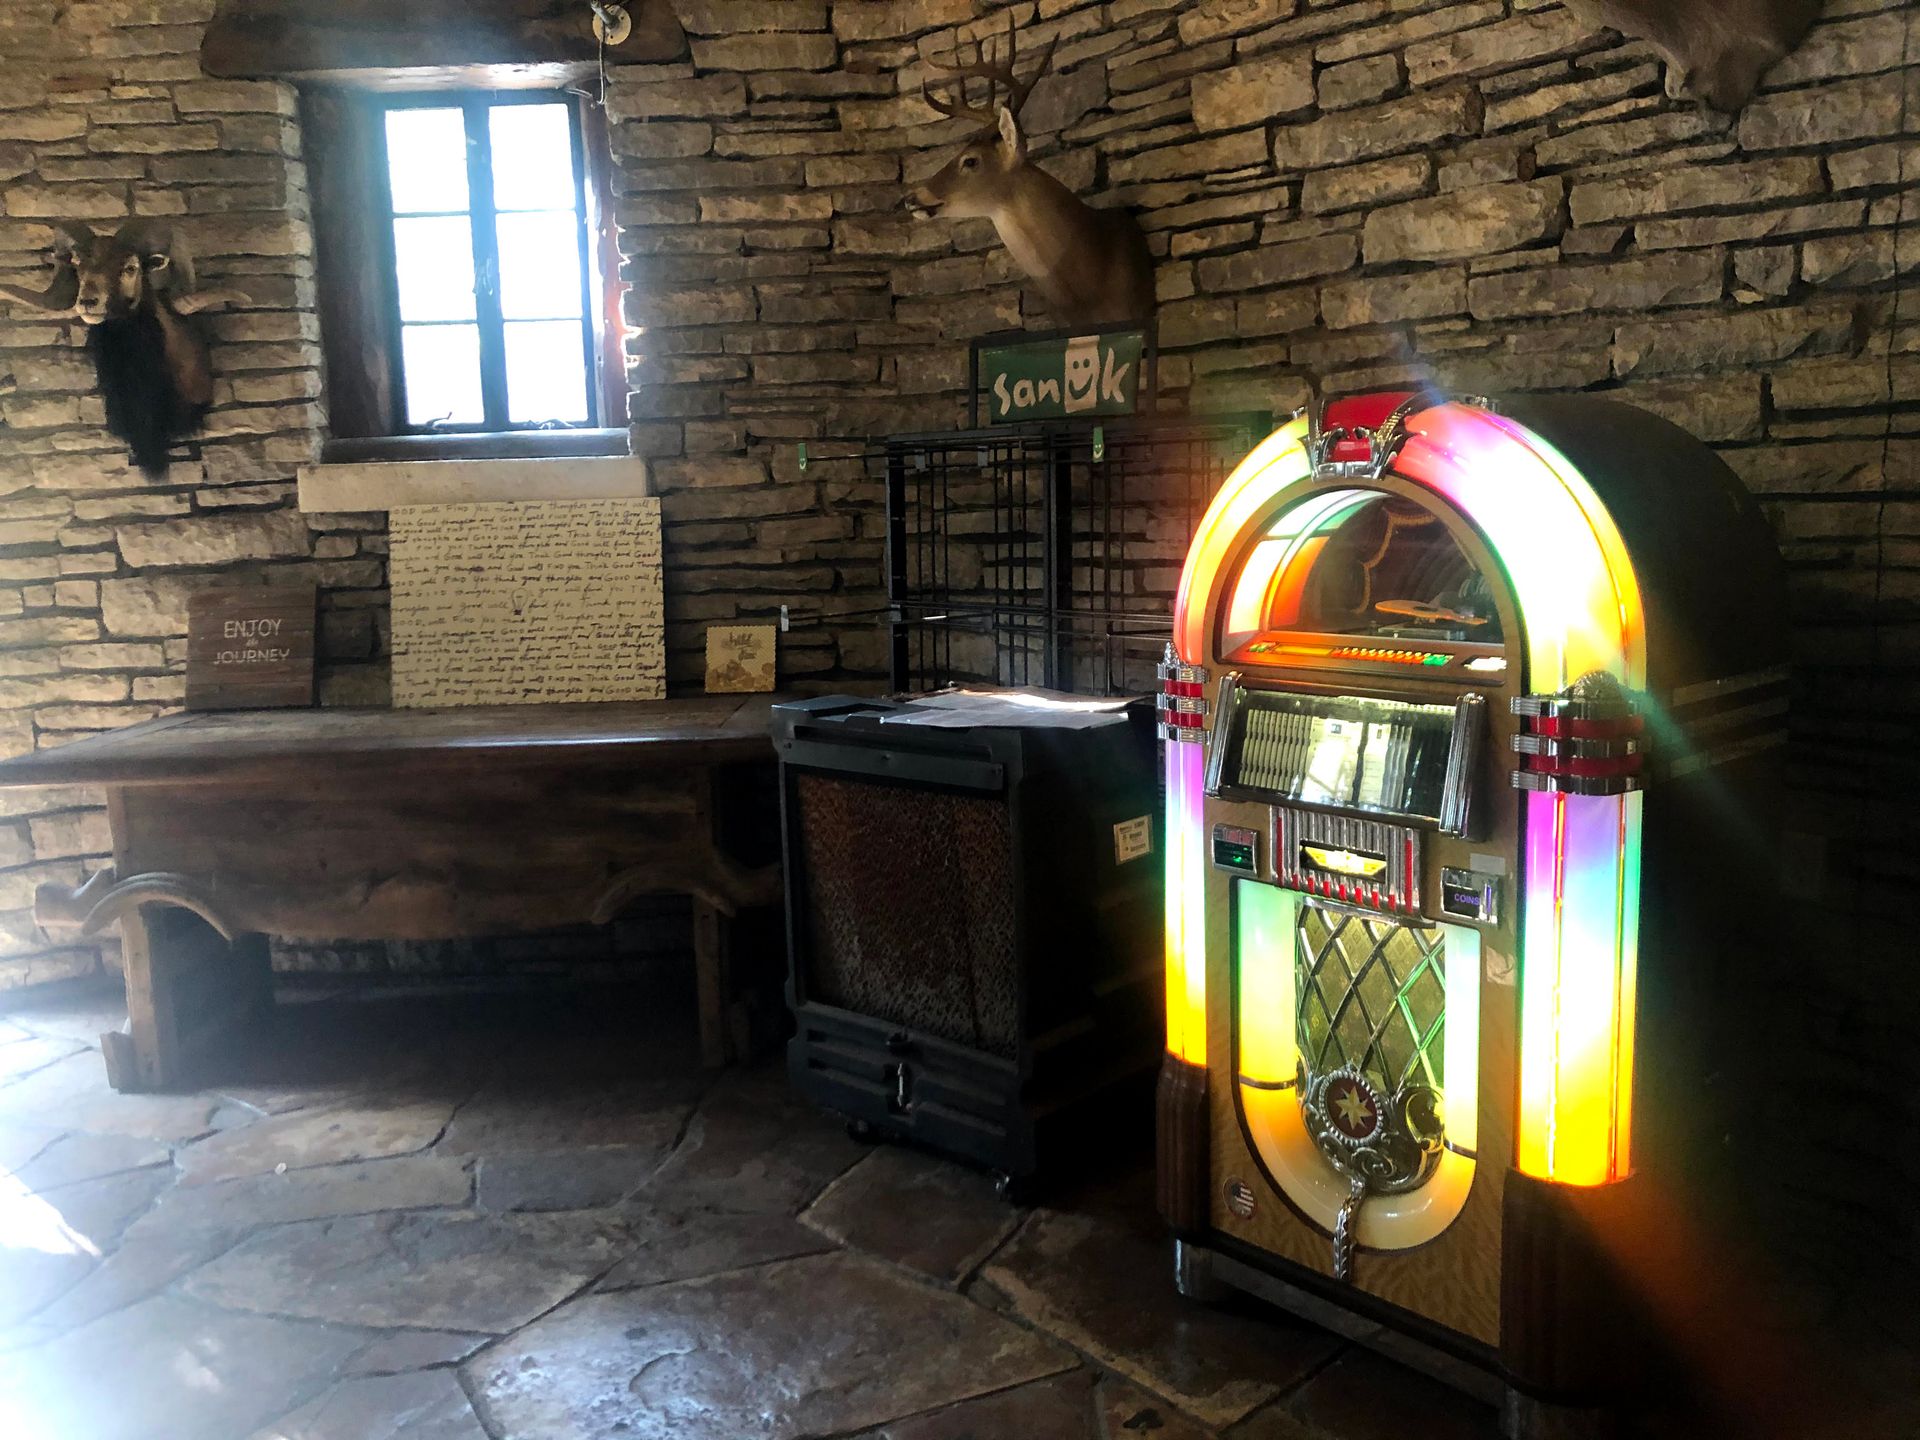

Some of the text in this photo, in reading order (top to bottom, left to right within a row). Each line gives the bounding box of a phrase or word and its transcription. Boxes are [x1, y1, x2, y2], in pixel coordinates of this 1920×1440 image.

[223, 618, 282, 639] ENJOY
[213, 648, 290, 665] JOURNEY
[1454, 893, 1480, 906] COINS
